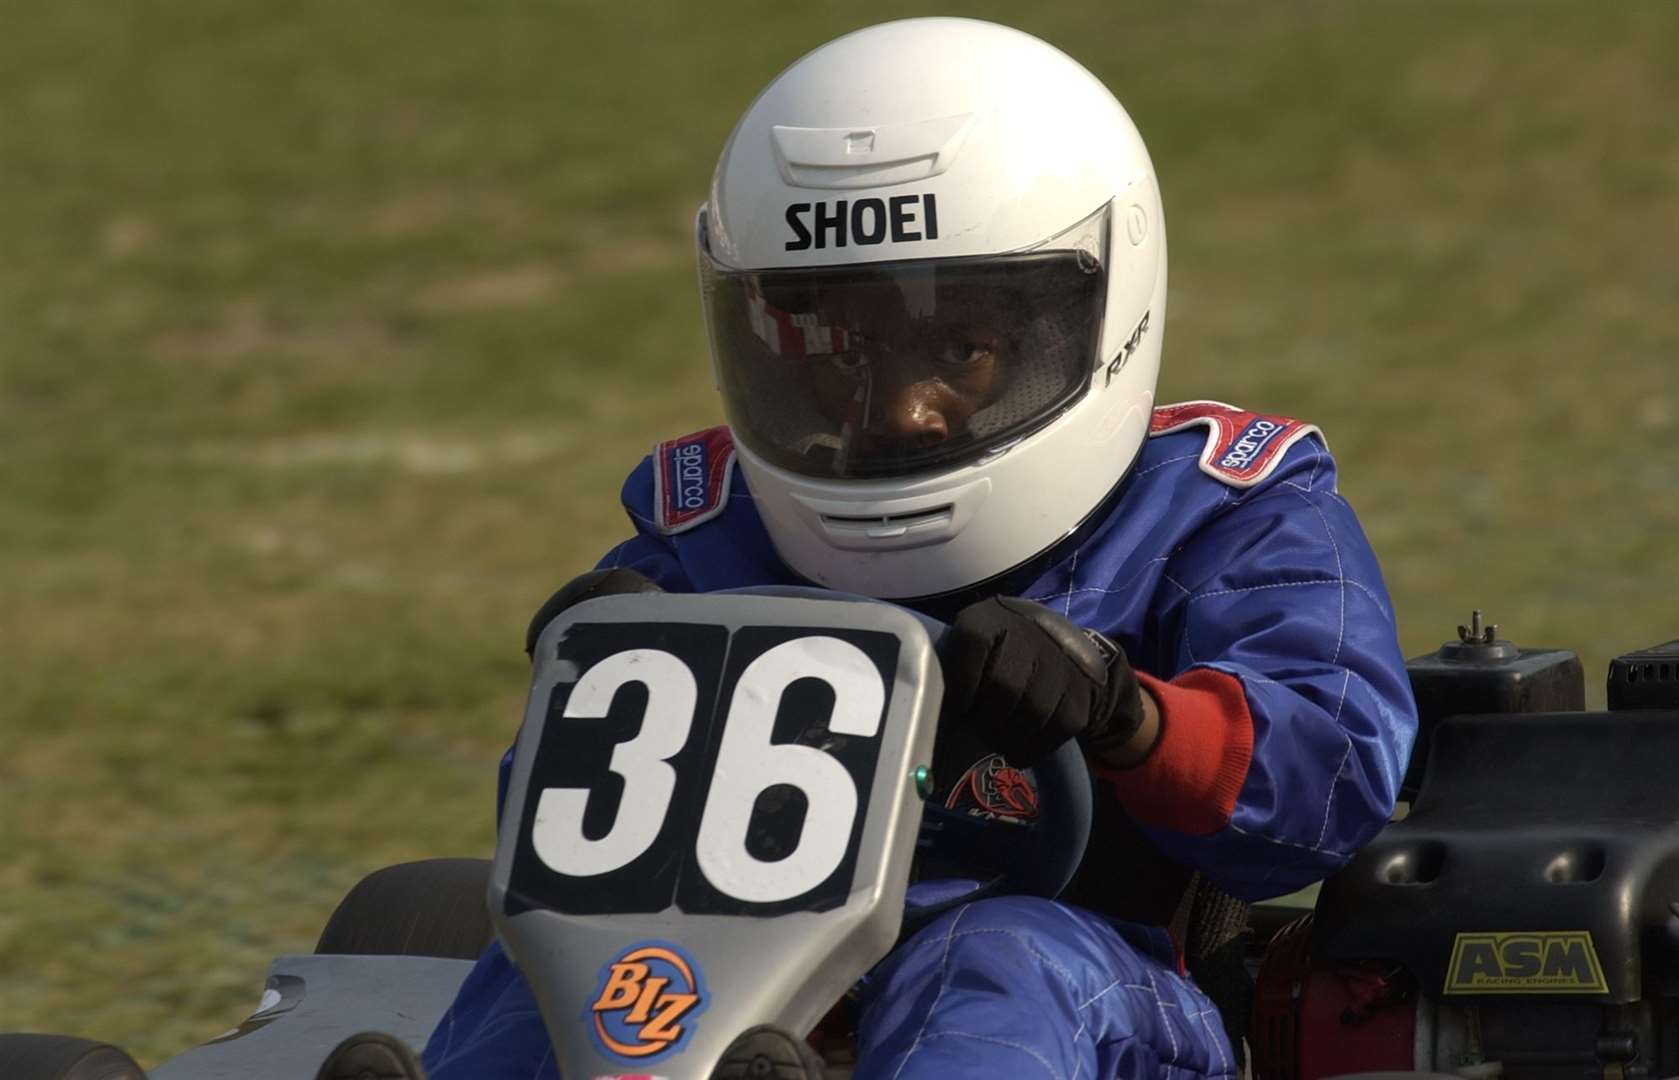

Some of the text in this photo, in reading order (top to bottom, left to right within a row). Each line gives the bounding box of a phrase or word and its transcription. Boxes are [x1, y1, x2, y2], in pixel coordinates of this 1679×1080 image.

[785, 194, 938, 251] SHOEI
[1221, 421, 1277, 467] sparco
[673, 445, 704, 508] sparco
[532, 636, 885, 902] 36
[1455, 940, 1597, 984] ASM
[592, 962, 699, 1040] BIZ
